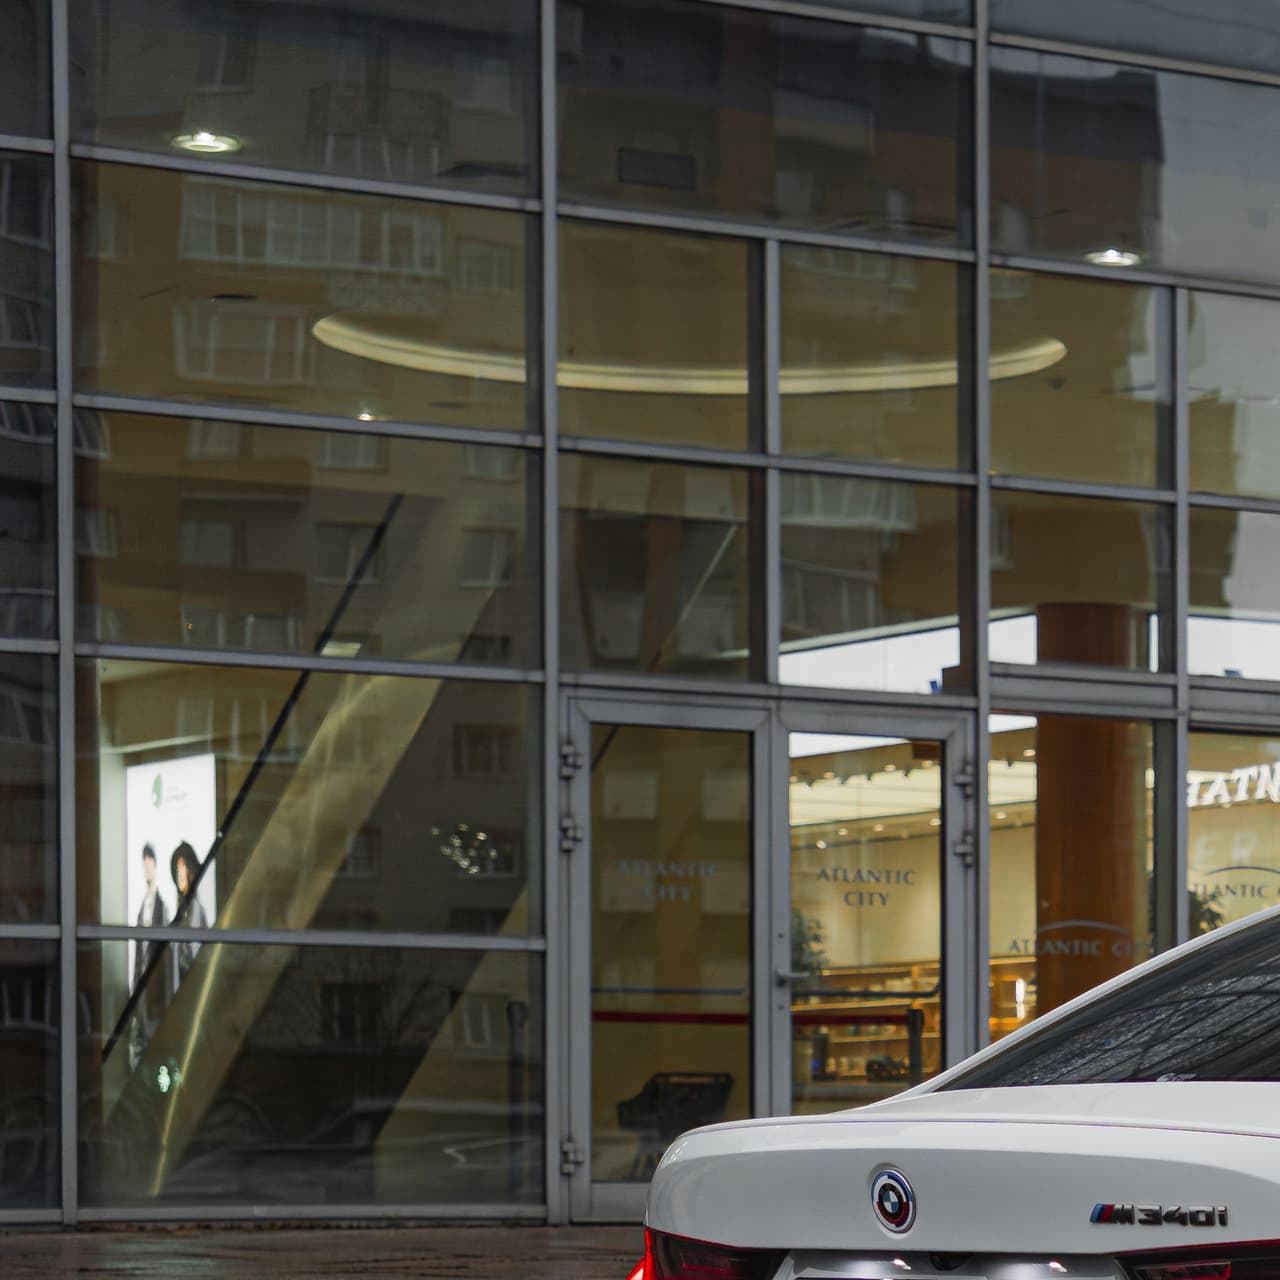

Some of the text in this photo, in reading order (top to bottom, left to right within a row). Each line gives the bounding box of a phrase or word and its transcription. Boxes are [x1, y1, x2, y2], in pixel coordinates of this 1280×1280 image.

[817, 866, 917, 886] ATLANTIC
[842, 891, 889, 907] CITY
[1192, 882, 1269, 898] TLANTIC
[1106, 1203, 1228, 1226] M340i
